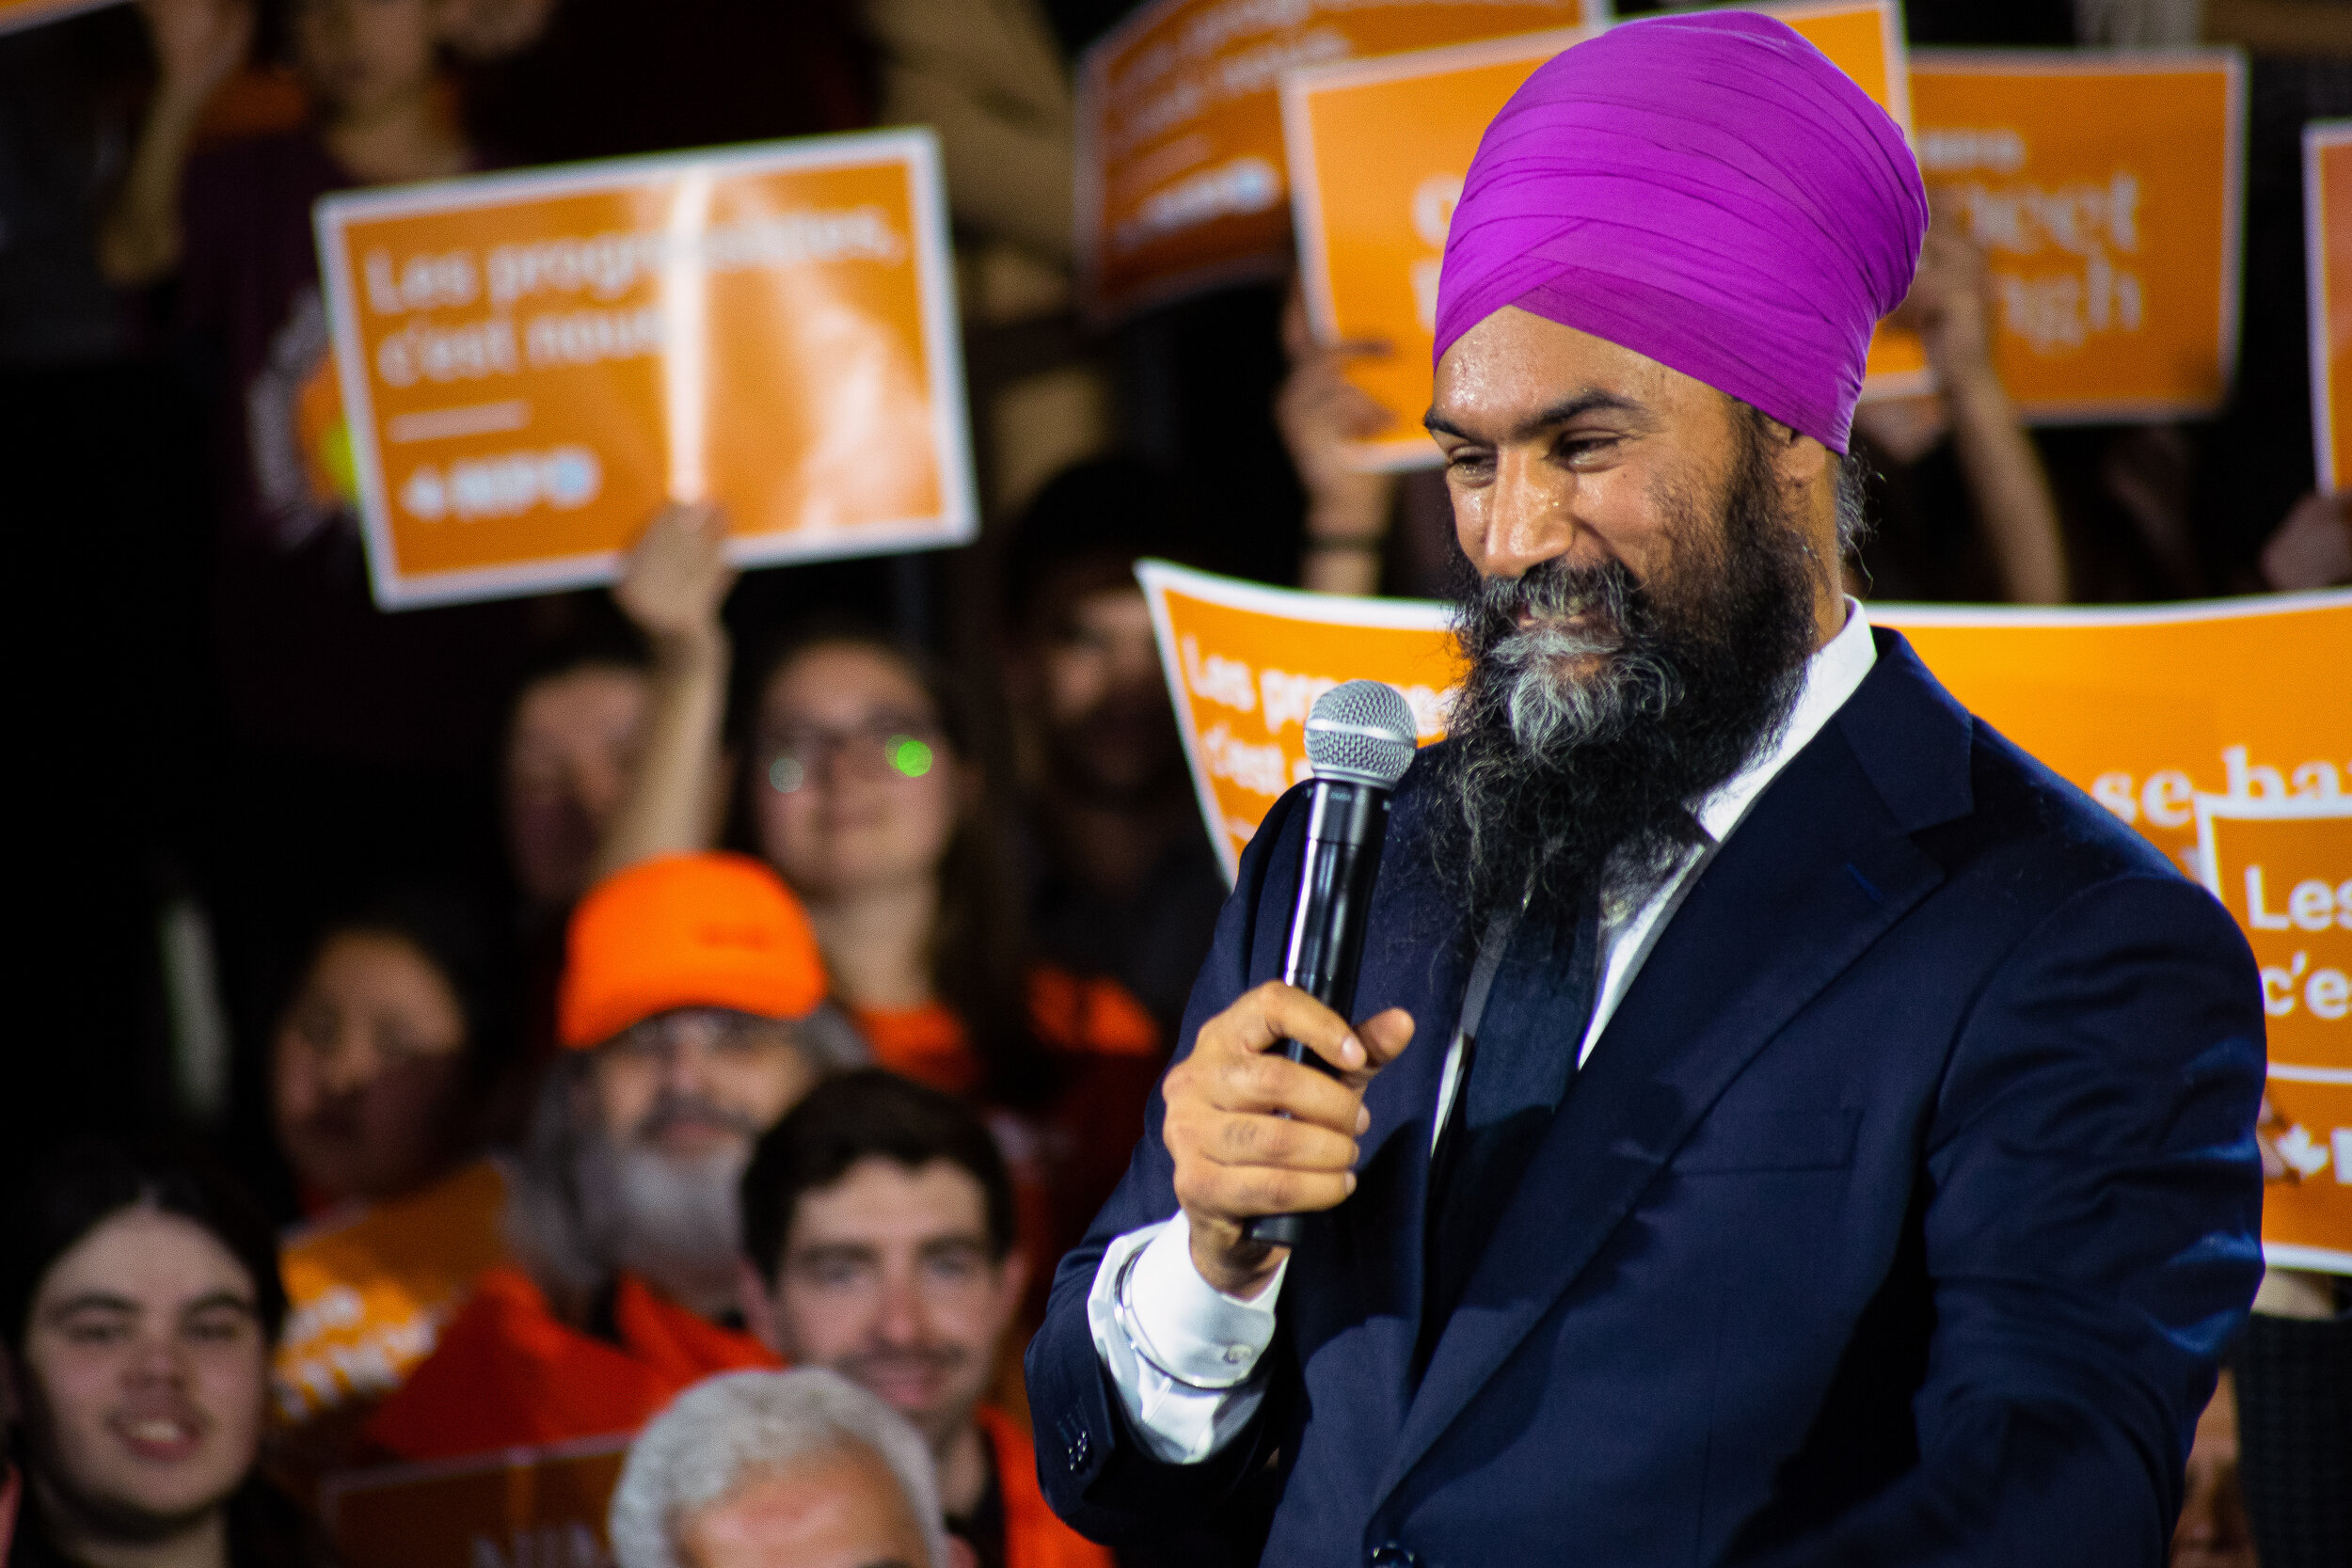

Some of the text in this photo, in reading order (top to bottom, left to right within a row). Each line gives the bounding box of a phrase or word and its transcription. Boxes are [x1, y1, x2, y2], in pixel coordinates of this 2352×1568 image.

[2090, 743, 2352, 828] se ba
[2260, 950, 2352, 1020] c'e
